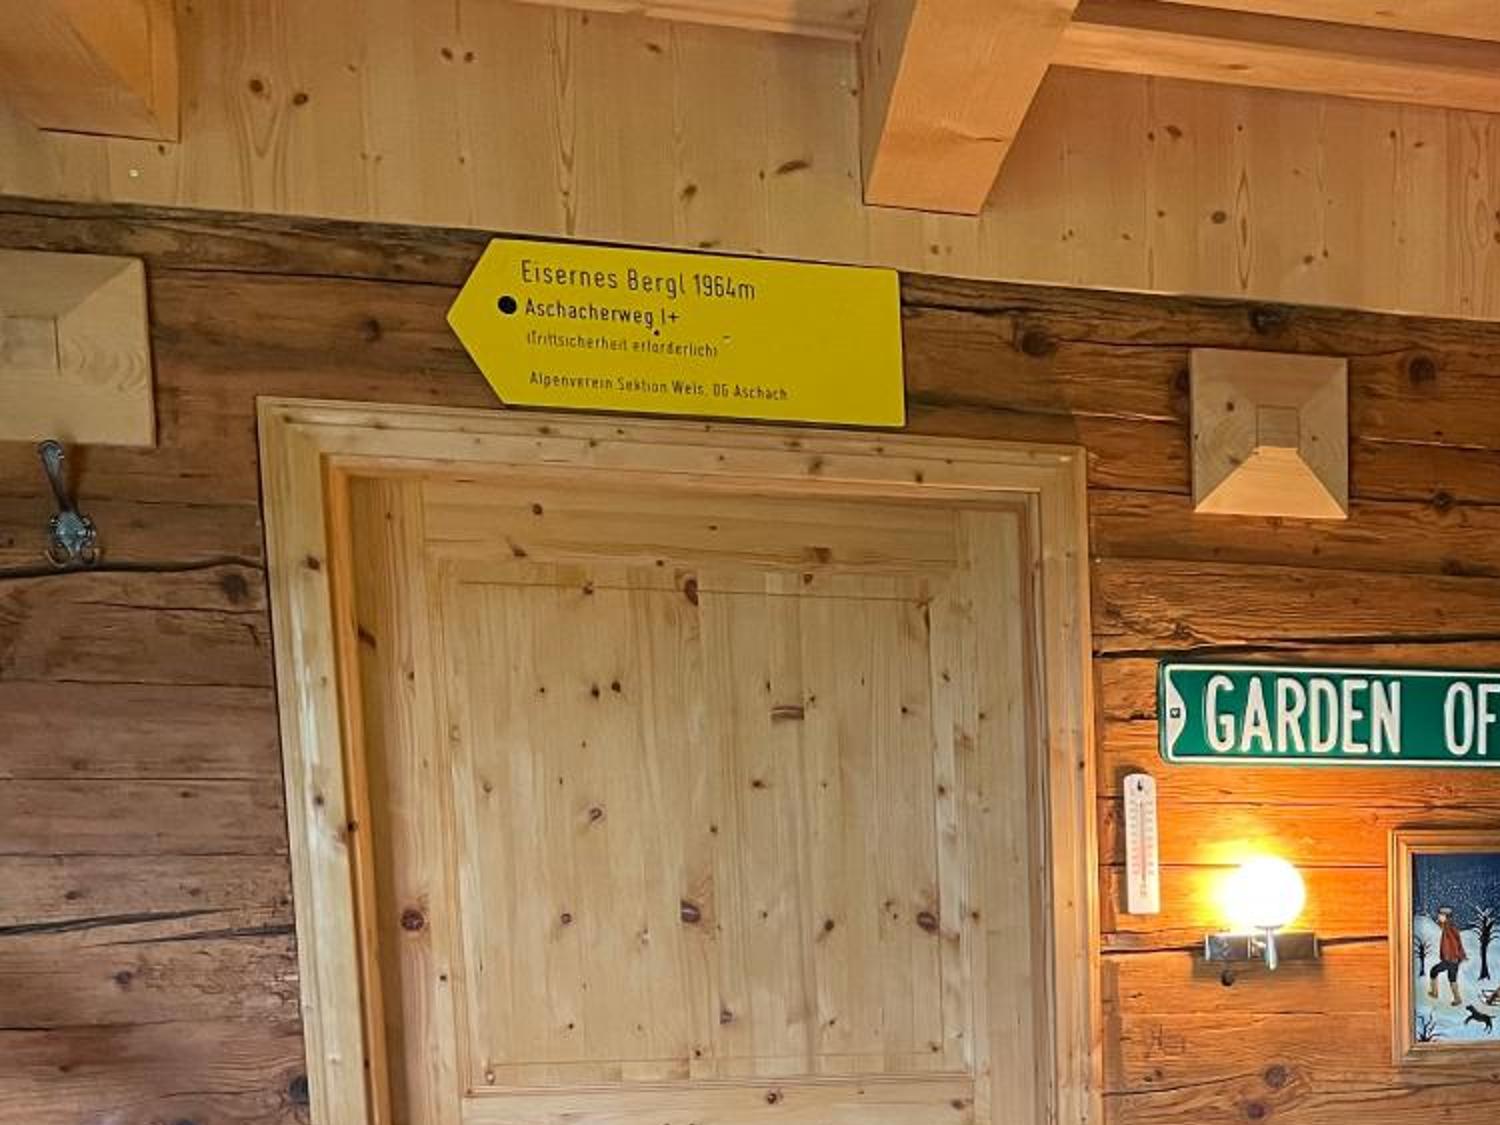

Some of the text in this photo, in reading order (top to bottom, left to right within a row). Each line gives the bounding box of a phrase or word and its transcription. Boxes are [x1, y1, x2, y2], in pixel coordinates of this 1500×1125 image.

[521, 259, 755, 300] Eisernes Bergl 1964m
[525, 297, 654, 329] Aschacherweg
[529, 371, 613, 389] Alpenverein
[617, 377, 668, 394] Sektion
[713, 383, 729, 398] OG
[733, 384, 788, 400] Aschach
[1204, 674, 1401, 756] GARDEN
